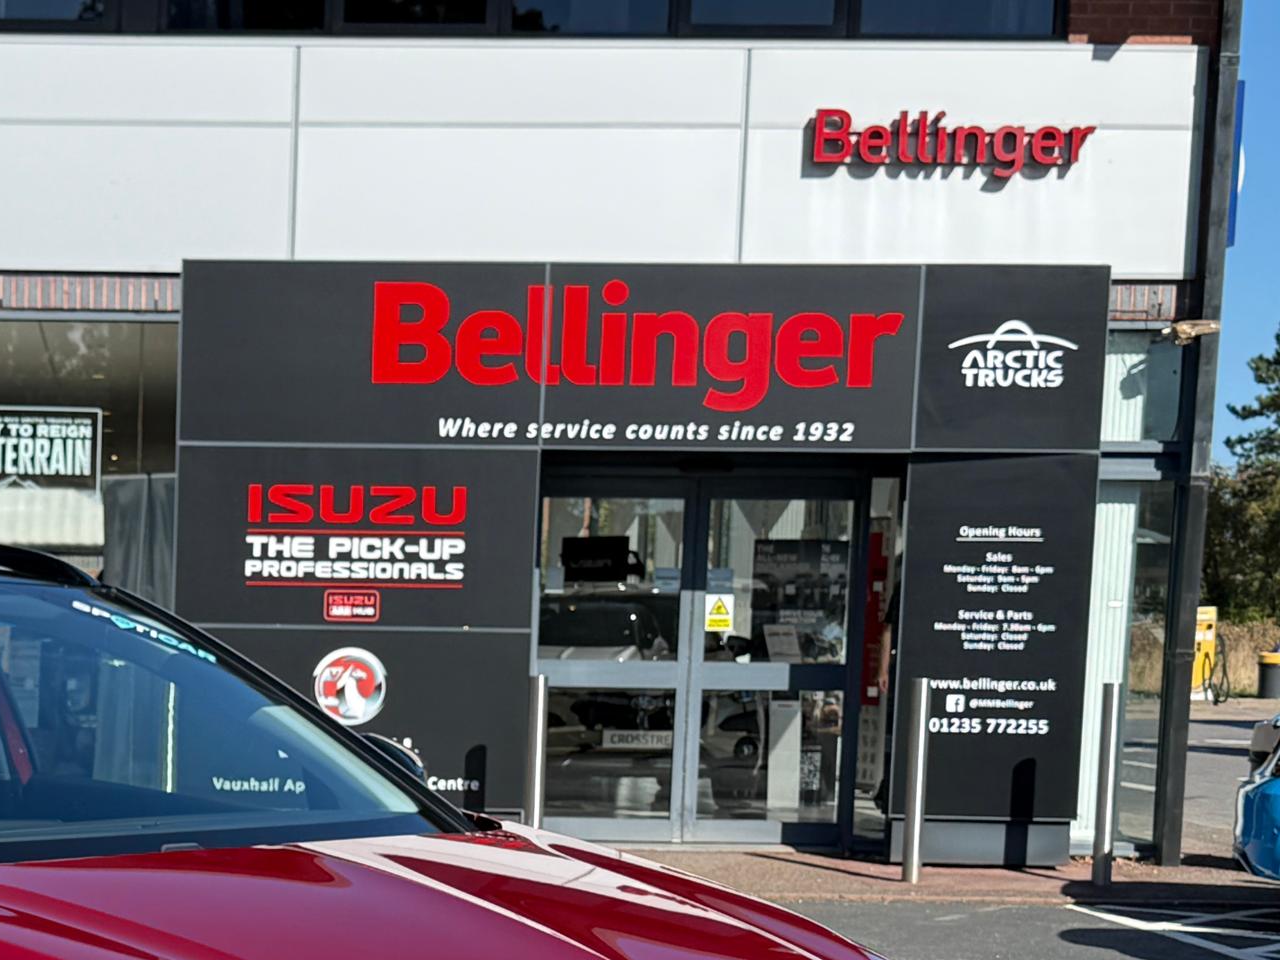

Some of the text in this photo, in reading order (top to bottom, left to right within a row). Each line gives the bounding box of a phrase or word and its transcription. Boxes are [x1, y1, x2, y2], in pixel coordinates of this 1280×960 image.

[813, 108, 1097, 178] Bellinger
[372, 280, 904, 412] Bellinger
[962, 350, 1064, 369] ARCTIC
[961, 369, 1064, 388] TRUCKS
[7, 423, 33, 437] TO
[36, 424, 92, 438] REIGN
[438, 418, 855, 441] Where service counts since 1932
[248, 484, 467, 525] ISUZU
[959, 525, 1041, 539] Opening Hours
[246, 535, 466, 560] THE PICK-UP
[985, 552, 1013, 562] Sales
[244, 560, 465, 580] PROFESSIONALS
[329, 595, 375, 605] ISUZU
[958, 609, 1033, 621] Service & Parts
[929, 717, 1049, 735] 01235 772255
[610, 732, 671, 746] CROSSTRE
[212, 776, 279, 792] Vauxhall
[427, 776, 480, 791] Centre
